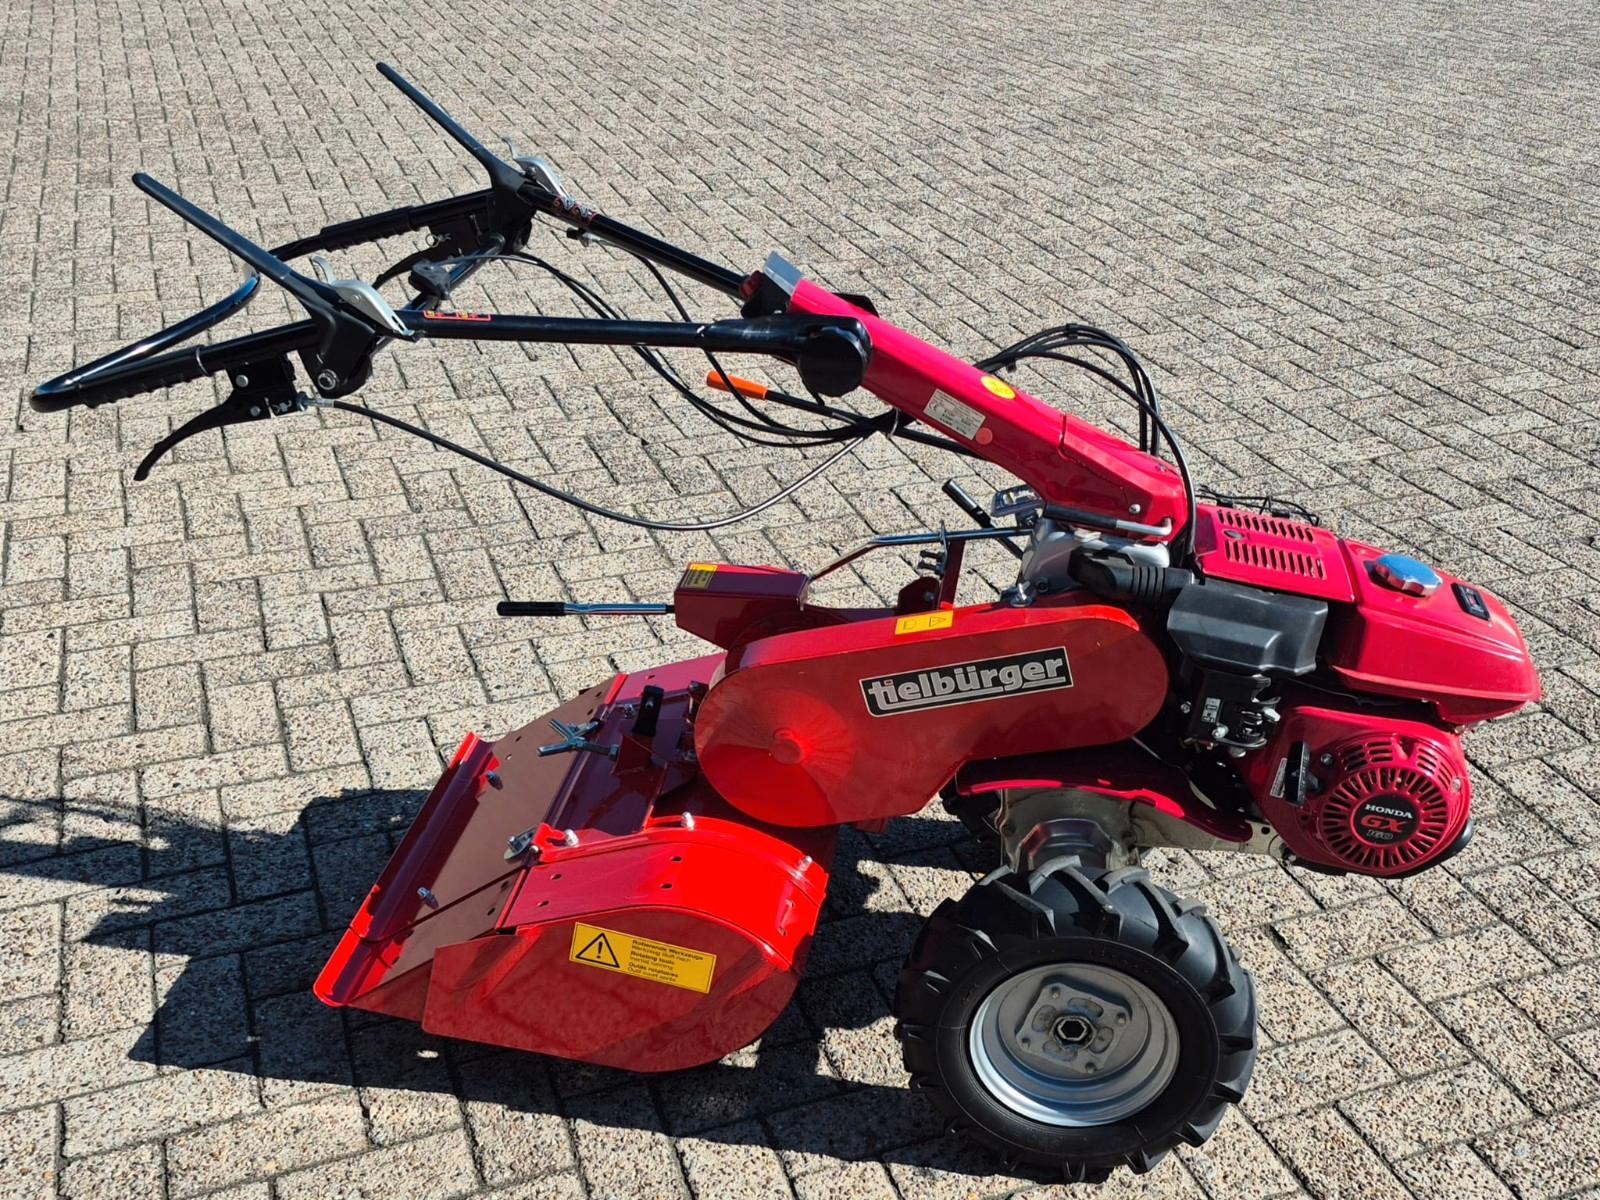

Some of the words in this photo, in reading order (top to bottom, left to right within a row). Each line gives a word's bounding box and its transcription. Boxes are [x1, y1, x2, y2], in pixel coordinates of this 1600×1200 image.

[868, 657, 1064, 711] tielbürger
[1364, 804, 1413, 819] HONDA
[1361, 815, 1406, 833] GX
[1366, 829, 1394, 840] 160
[630, 951, 658, 962] Rotating
[659, 957, 675, 965] tools
[632, 940, 667, 952] Rotierende
[668, 948, 704, 961] Werkzeuge
